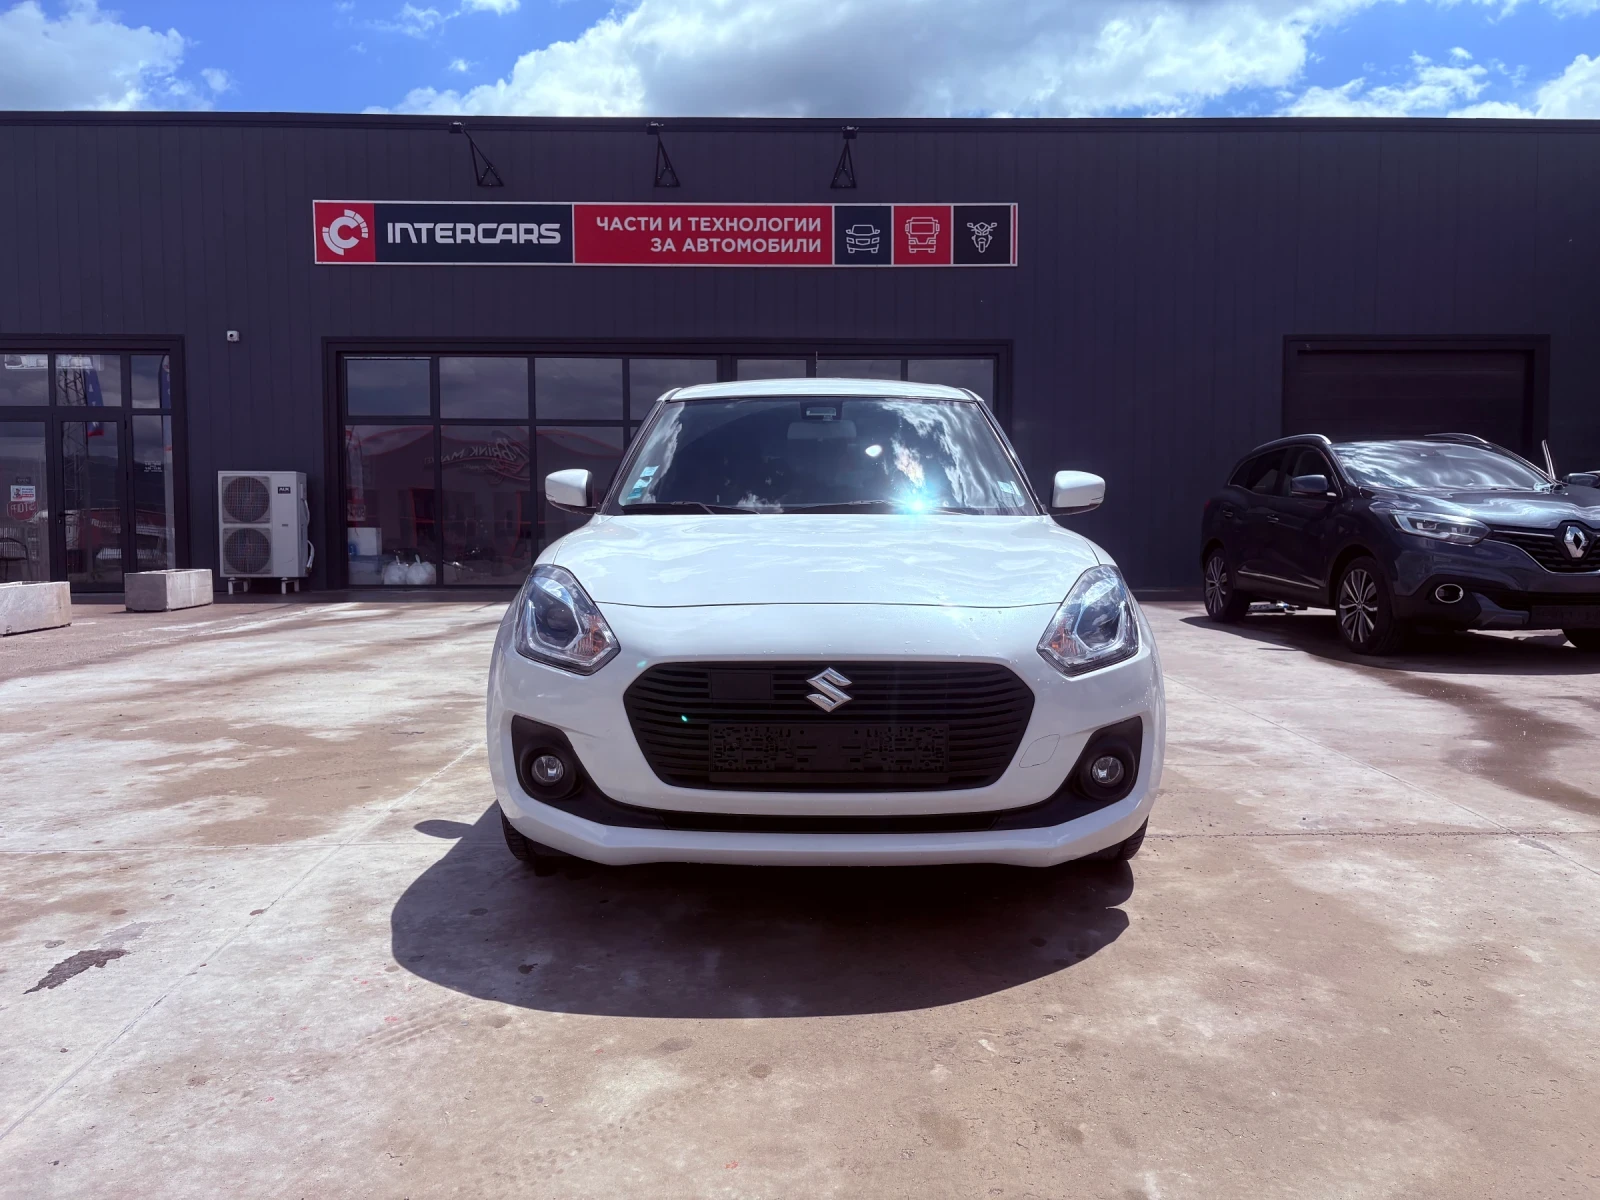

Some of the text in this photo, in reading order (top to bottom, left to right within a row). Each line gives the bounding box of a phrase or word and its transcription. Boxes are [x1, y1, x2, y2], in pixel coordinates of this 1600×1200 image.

[596, 216, 821, 232] ЧАСТИ И ТЕХНОЛОГИИ
[387, 222, 562, 244] INTERCARS
[650, 237, 821, 253] ЗА АВТОМОБИЛИ
